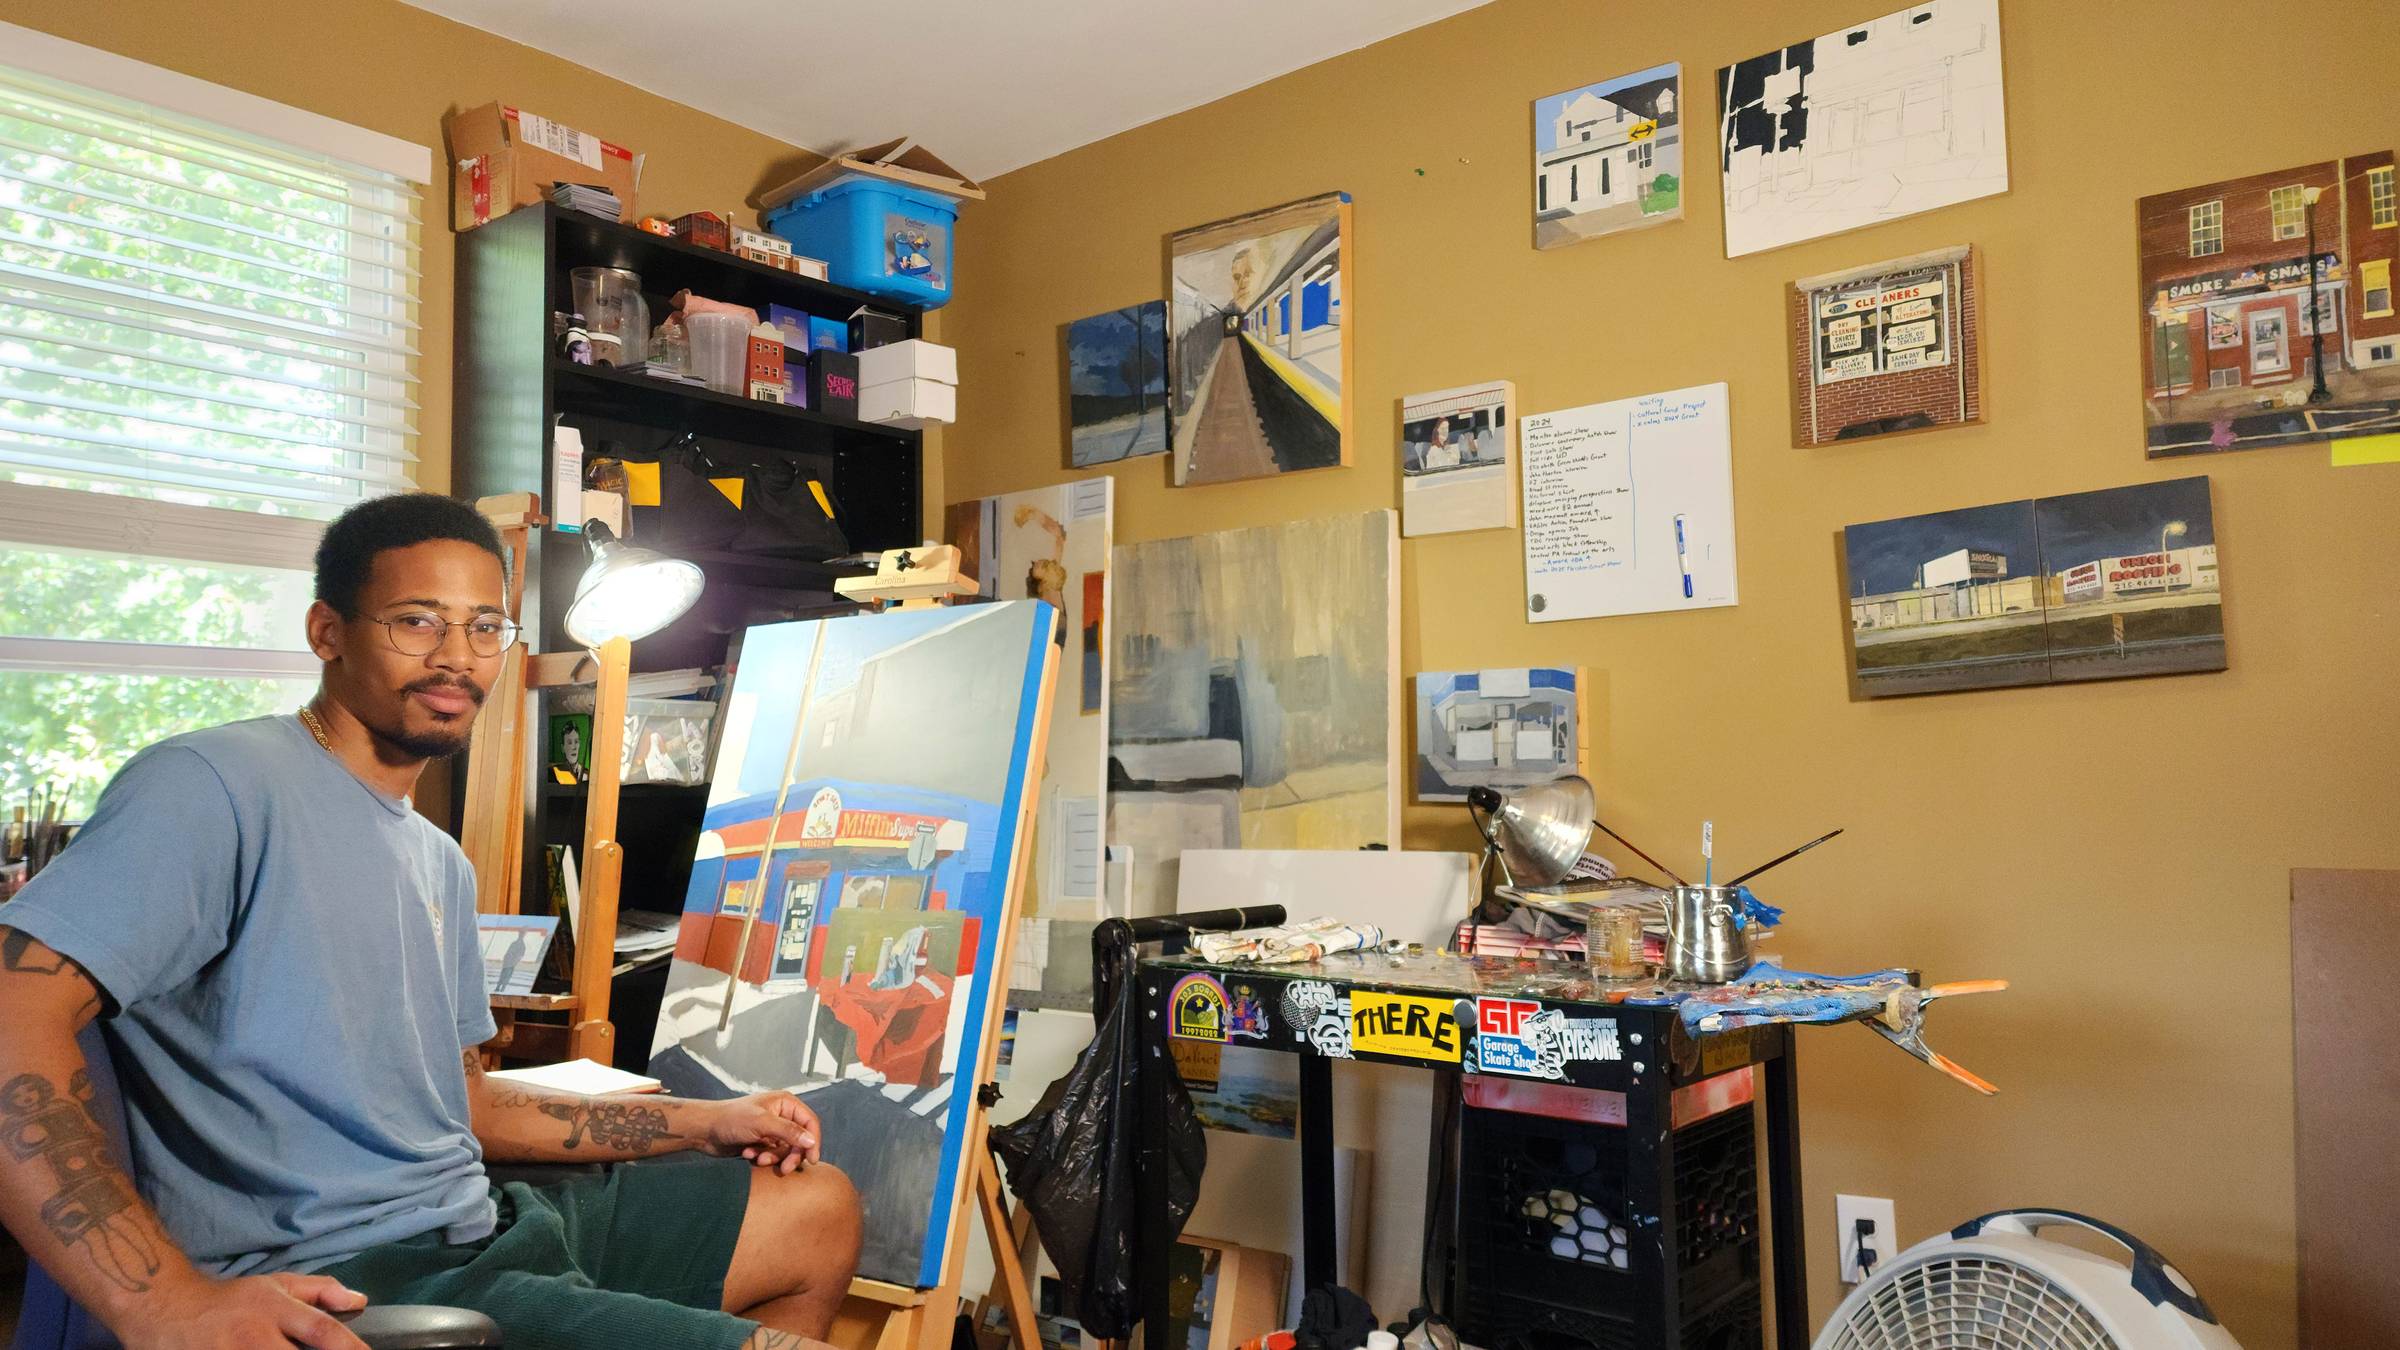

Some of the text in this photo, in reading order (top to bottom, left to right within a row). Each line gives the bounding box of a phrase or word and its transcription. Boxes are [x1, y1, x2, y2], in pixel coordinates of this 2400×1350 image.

[1855, 287, 1920, 309] CLEANERS
[2170, 278, 2223, 298] SMOKE
[1529, 418, 1551, 428] 2024
[1576, 862, 1612, 880] Importa
[1193, 984, 1221, 1007] BOARDS
[1353, 1003, 1455, 1054] THERE
[1483, 1037, 1520, 1056] Garage
[1563, 1028, 1622, 1061] EYESORE
[1484, 1051, 1511, 1066] Skate
